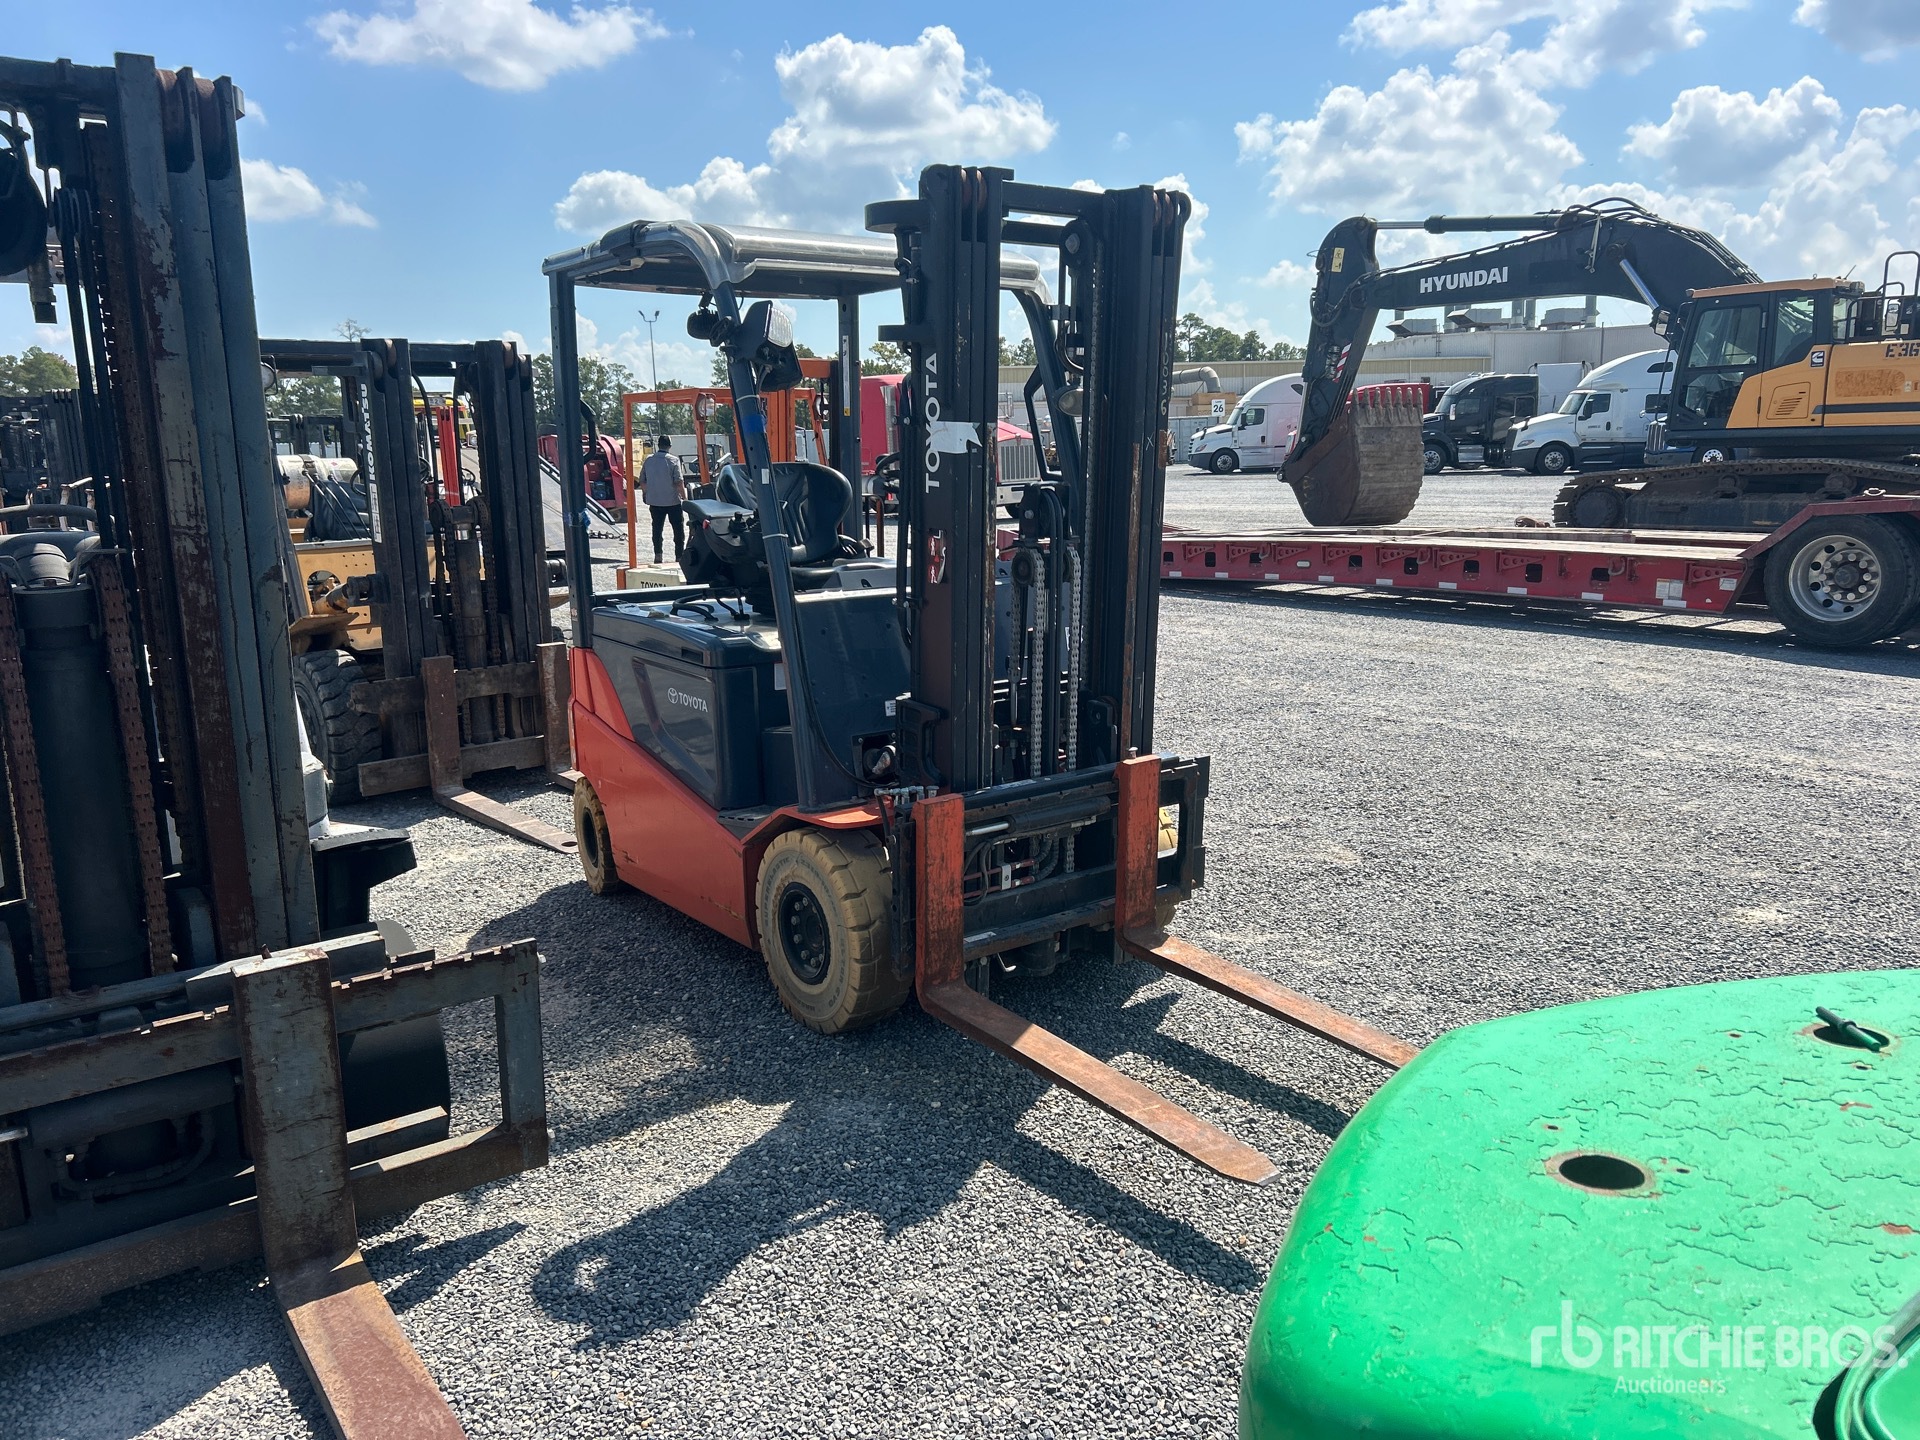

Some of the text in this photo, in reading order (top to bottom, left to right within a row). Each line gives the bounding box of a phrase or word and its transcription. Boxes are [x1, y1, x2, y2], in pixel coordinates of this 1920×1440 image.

[1420, 267, 1508, 293] HYUNDAI
[1213, 404, 1224, 413] 26
[360, 383, 376, 481] KOMATSU
[678, 692, 709, 713] TOYOTA
